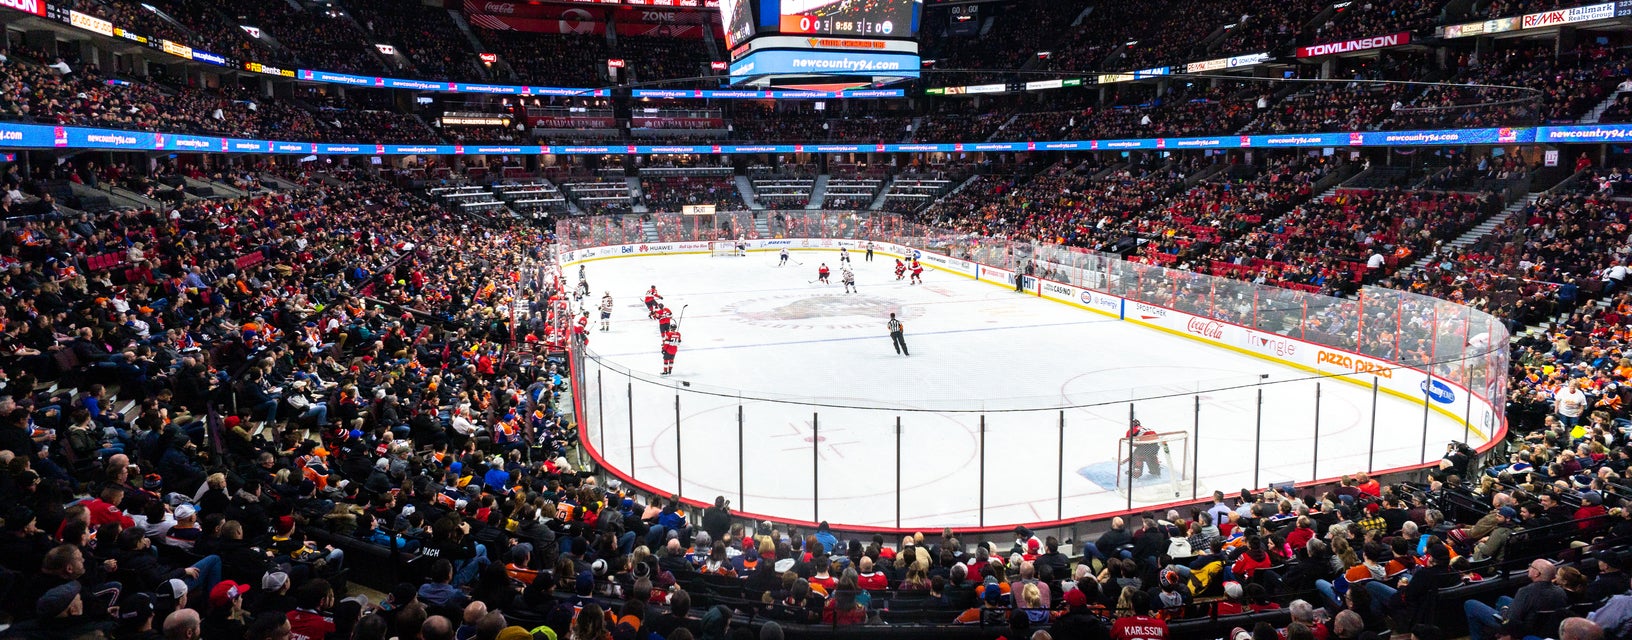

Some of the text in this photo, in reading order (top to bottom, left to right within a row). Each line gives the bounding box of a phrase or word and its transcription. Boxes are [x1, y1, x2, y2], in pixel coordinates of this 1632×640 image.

[1569, 3, 1613, 16] Hallmark
[642, 11, 675, 22] ZONE
[1524, 10, 1566, 27] RE/MAX
[1568, 12, 1613, 22] Realty Group
[1305, 34, 1398, 57] TOMLINSON
[793, 58, 900, 71] newcountry94.com
[393, 81, 441, 90] newcountry94.com
[88, 134, 136, 145] newcountry94.com
[1268, 136, 1322, 145] newcountry94.com
[1387, 132, 1459, 142] newcountry94.com
[621, 246, 634, 254] Bell
[1054, 285, 1071, 297] CASINO
[1317, 350, 1393, 379] pizza pizza
[1124, 625, 1163, 637] KARLSSON
